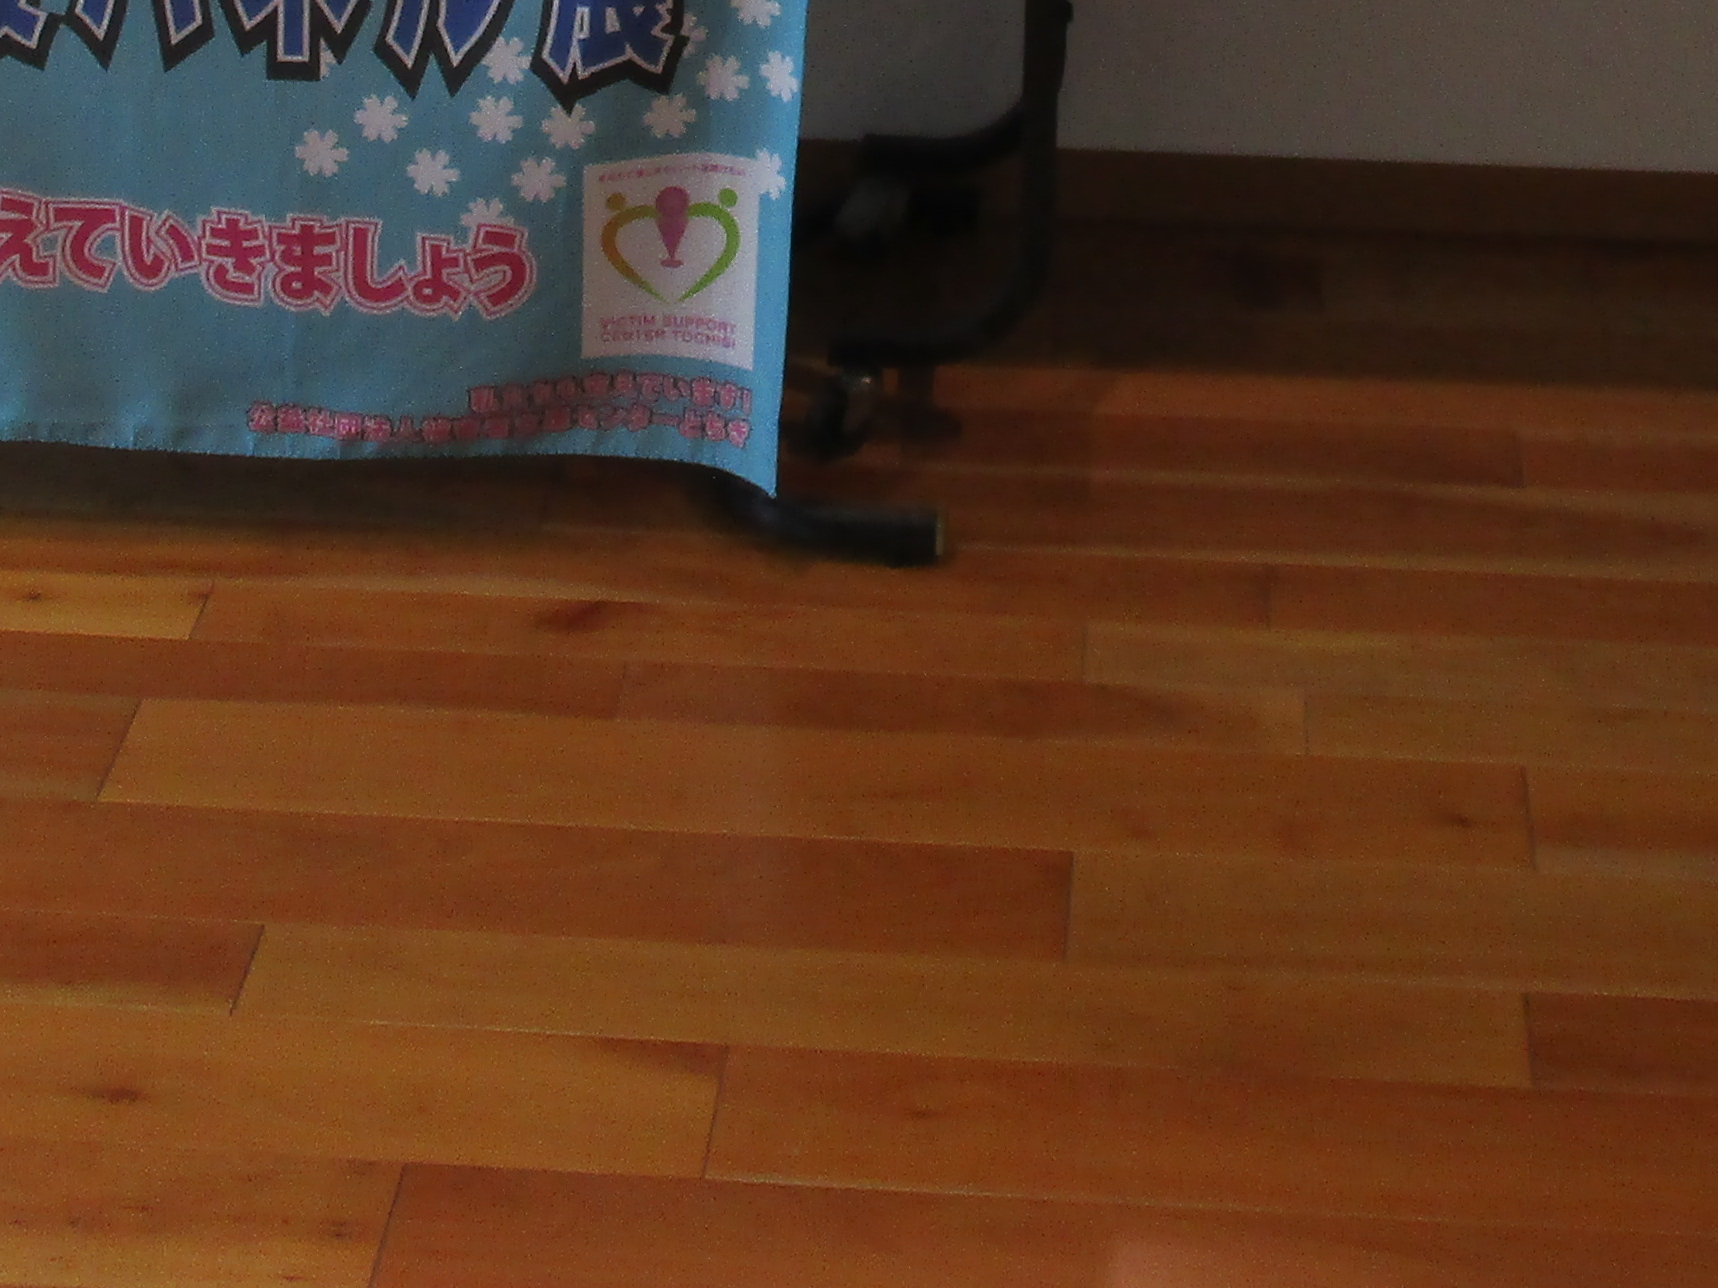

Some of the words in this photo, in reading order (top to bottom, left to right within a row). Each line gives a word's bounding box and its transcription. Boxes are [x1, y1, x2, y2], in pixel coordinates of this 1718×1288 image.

[600, 314, 656, 329] VICTIM
[662, 315, 737, 334] SUPPORT
[600, 329, 666, 343] CENTER
